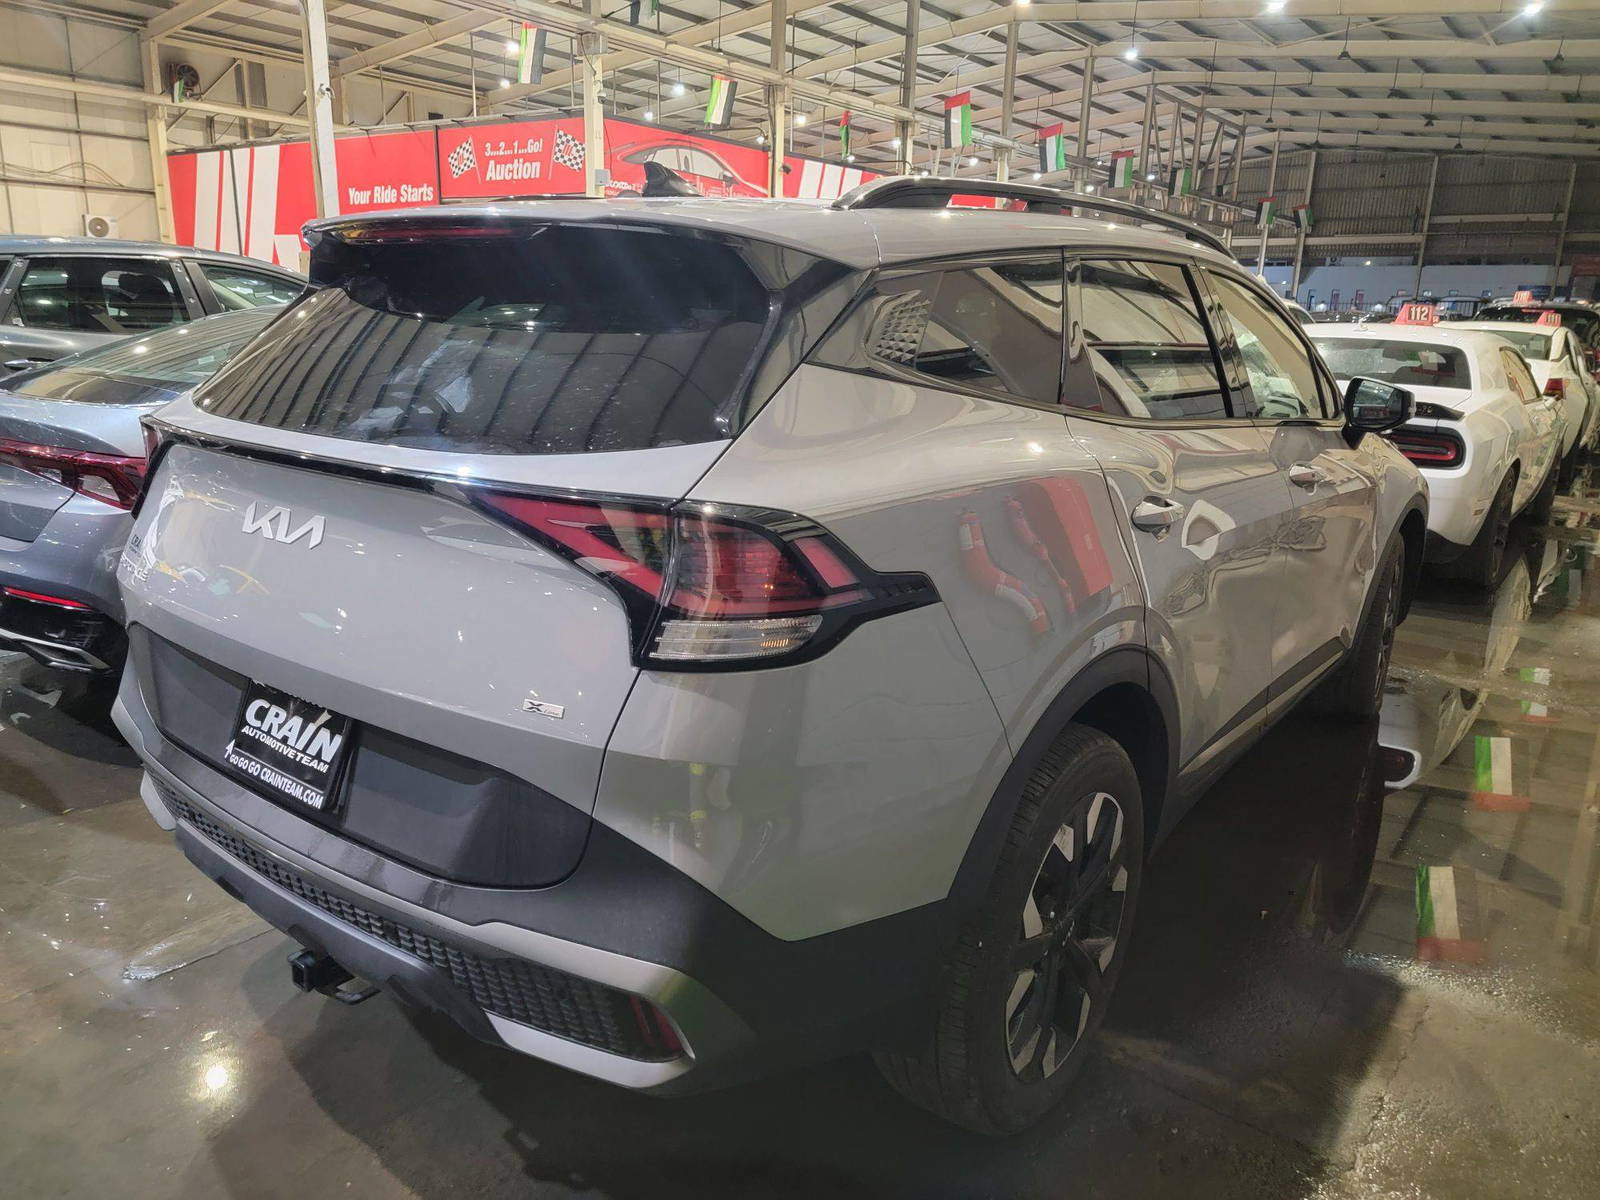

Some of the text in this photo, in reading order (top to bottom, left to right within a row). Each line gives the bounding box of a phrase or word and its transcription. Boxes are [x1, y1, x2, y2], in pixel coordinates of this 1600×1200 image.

[485, 159, 541, 182] Auction
[348, 183, 434, 205] Your Ride Starts
[1410, 306, 1428, 321] 112
[241, 500, 327, 550] KIA
[245, 698, 343, 763] CRAIN
[229, 754, 324, 809] GO GO GO CRAINTEAM.COM
